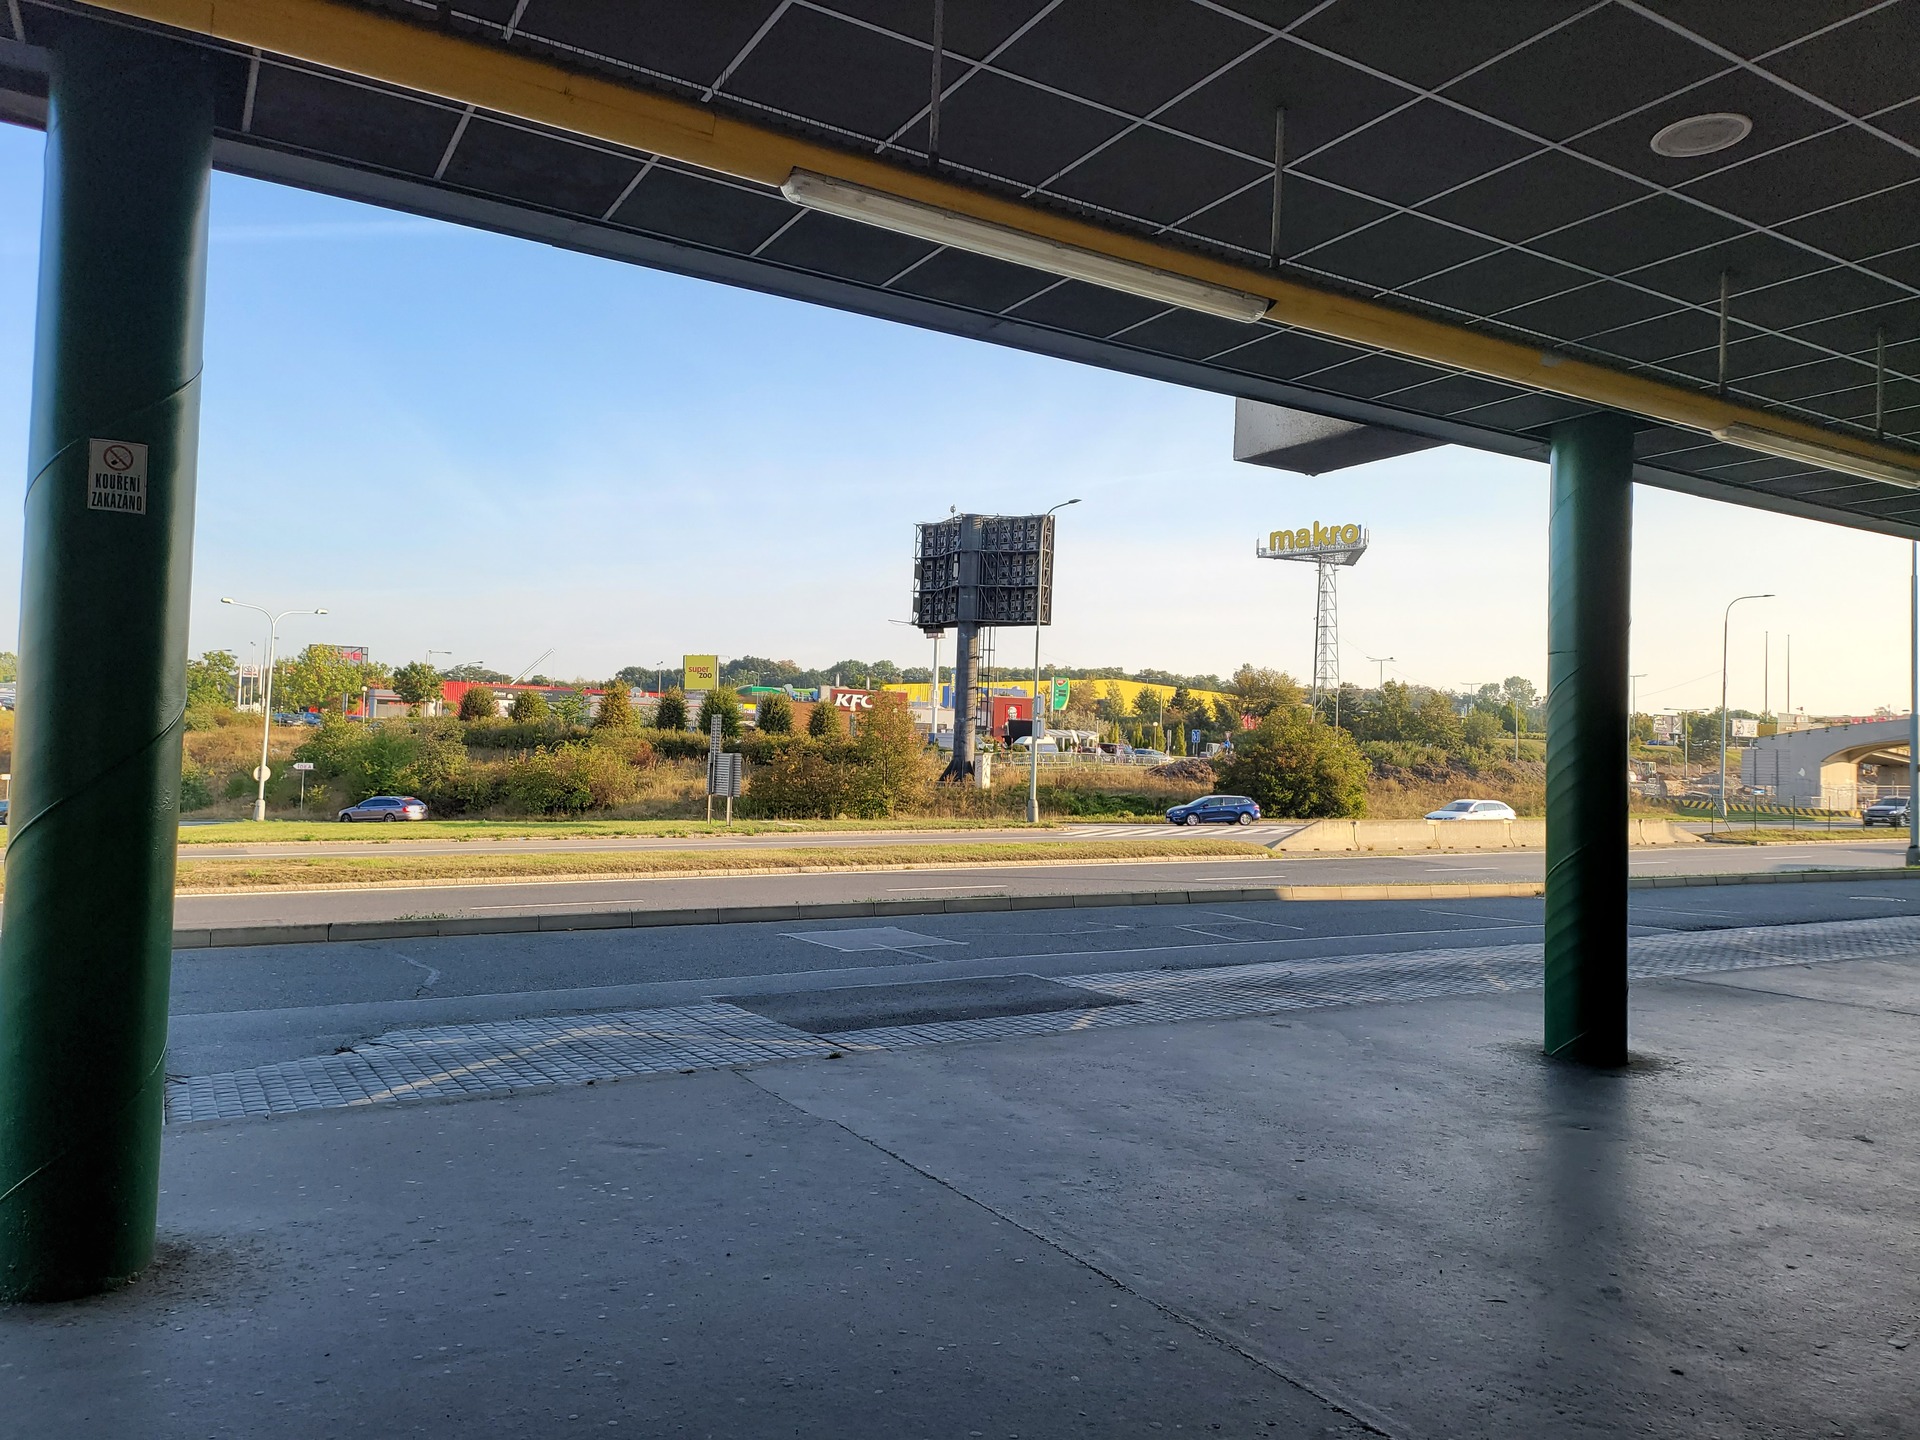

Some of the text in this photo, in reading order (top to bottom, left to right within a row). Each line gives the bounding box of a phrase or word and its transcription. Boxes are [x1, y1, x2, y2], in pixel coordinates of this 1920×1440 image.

[95, 473, 141, 493] KOUŘENÍ
[91, 490, 142, 511] ZAKÁZÁNO
[1269, 520, 1359, 551] makro
[688, 666, 710, 674] super
[834, 693, 873, 708] KFC
